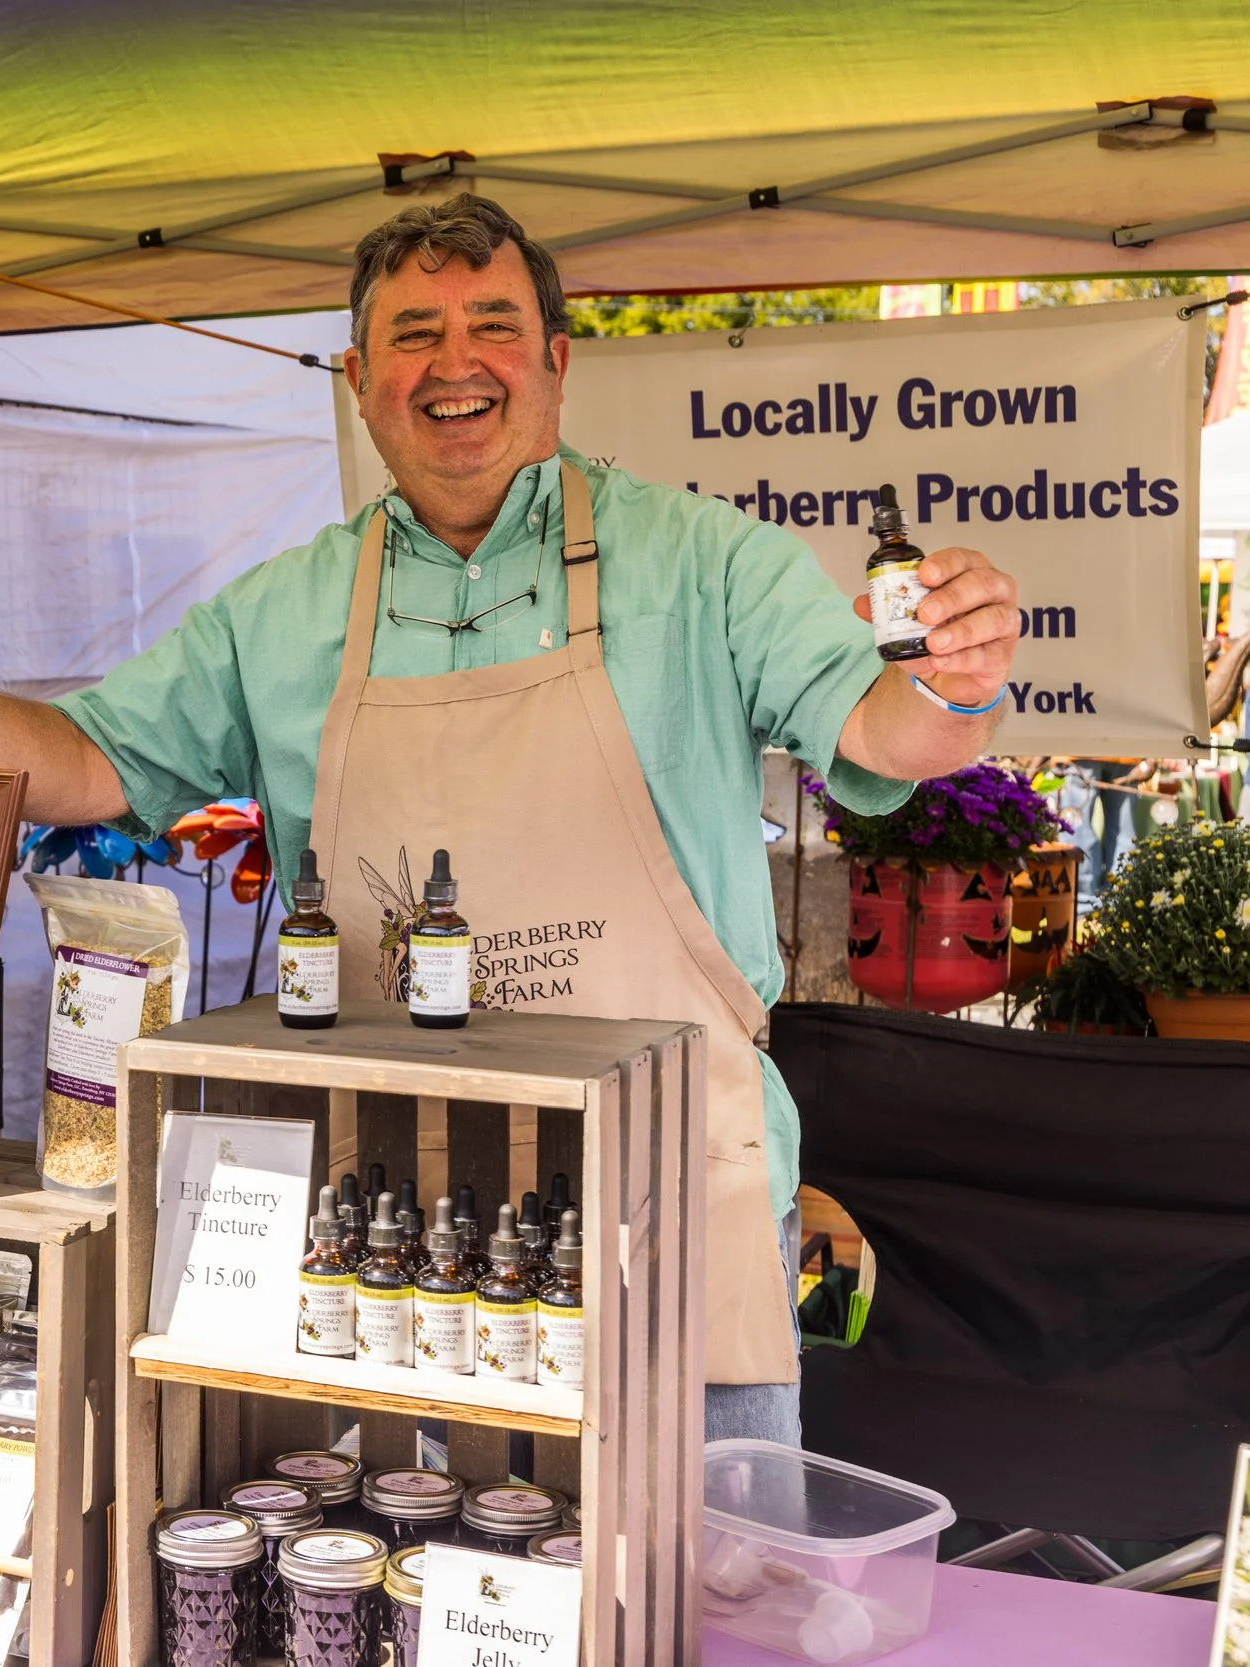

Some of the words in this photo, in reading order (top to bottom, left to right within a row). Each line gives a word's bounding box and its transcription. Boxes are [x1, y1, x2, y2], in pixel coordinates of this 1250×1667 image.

[690, 381, 878, 442] Locally
[897, 377, 1077, 430] Grown
[916, 466, 1180, 525] Products
[1007, 682, 1097, 714] York
[470, 919, 607, 955] DERBERRY
[75, 952, 94, 963] DRIED
[94, 956, 140, 973] ELDERFLOWER
[299, 951, 335, 959] ELDERBERRY
[475, 948, 579, 979] SPRINGS
[308, 984, 328, 993] FARM
[425, 985, 447, 993] FARM
[494, 977, 574, 1005] FARM
[84, 1010, 103, 1021] FARM
[179, 1181, 282, 1212] Elderberry
[188, 1211, 268, 1237] Tincture
[184, 1264, 195, 1283] $
[206, 1266, 256, 1288] 15.00
[309, 1289, 348, 1297] ELDERBERRY
[318, 1324, 339, 1332] FARM
[435, 1343, 456, 1352] FARM
[501, 1354, 523, 1362] FARM
[445, 1609, 554, 1653] Elderberry
